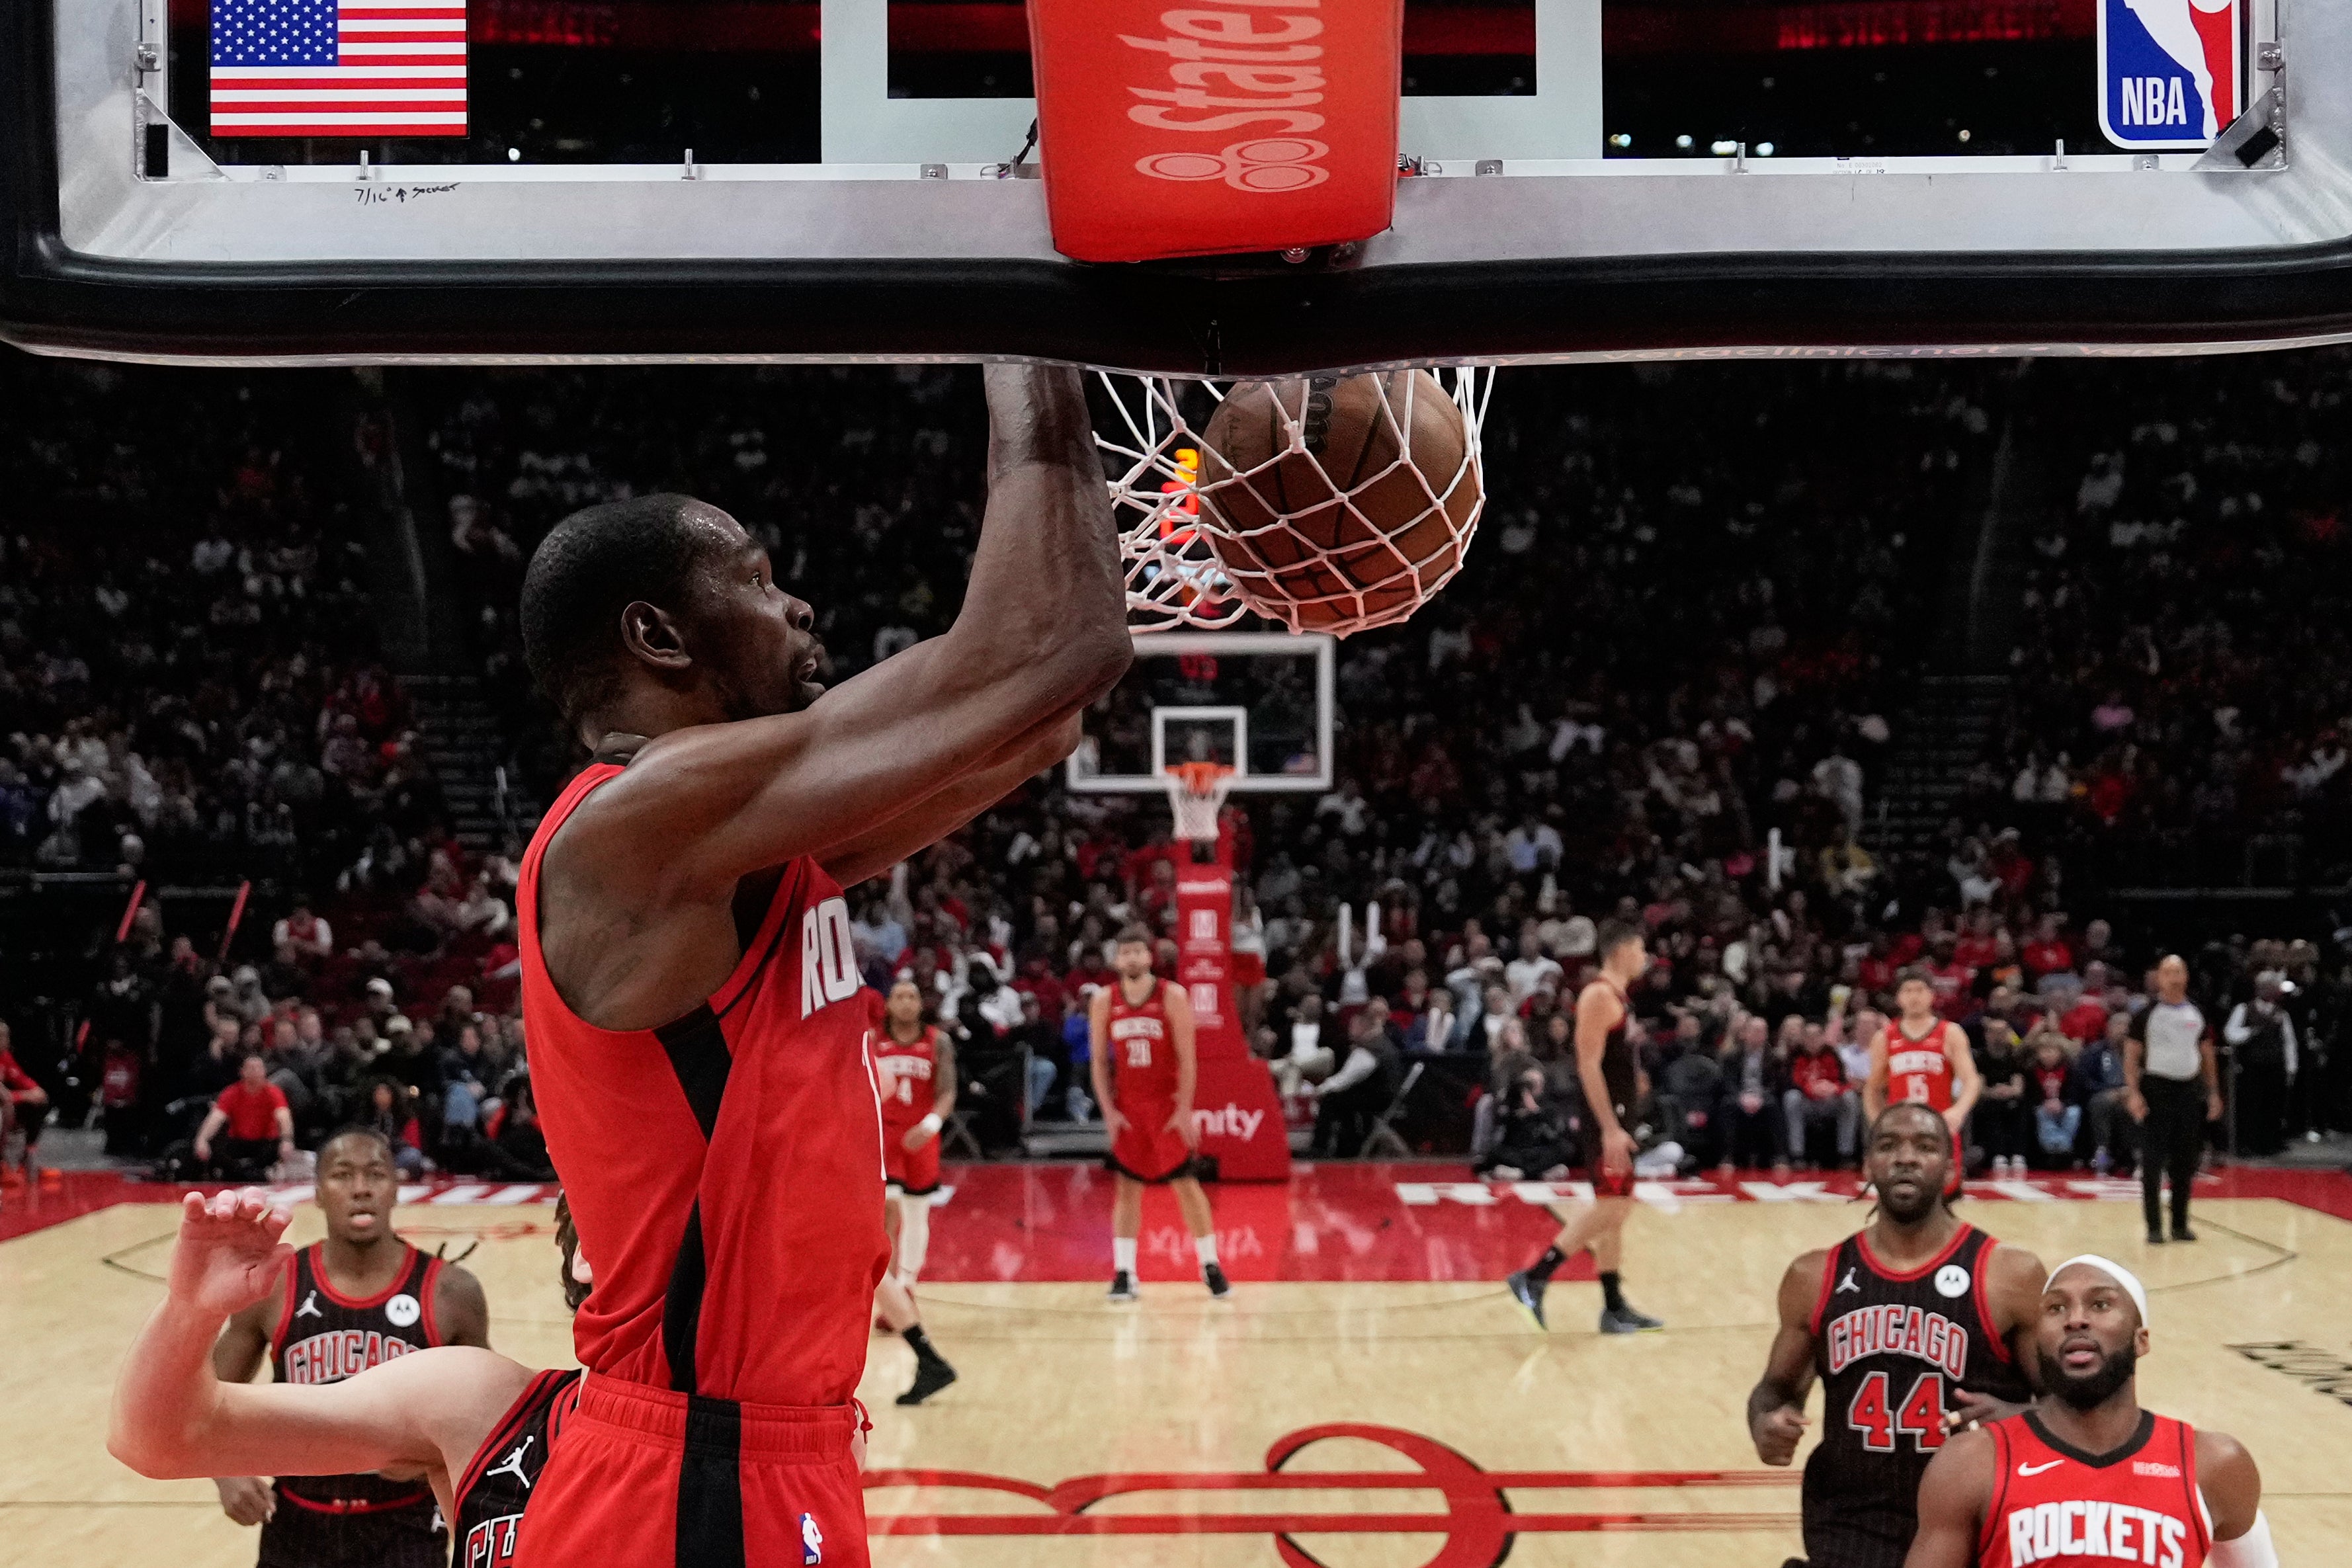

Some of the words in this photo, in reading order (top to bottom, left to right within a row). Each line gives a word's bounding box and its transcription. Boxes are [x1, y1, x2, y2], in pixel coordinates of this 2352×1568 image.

[2122, 77, 2187, 125] NBA
[896, 1076, 913, 1106] 4
[284, 1329, 422, 1384] CHICA
[1827, 1303, 1969, 1383] CHICAGO
[1847, 1370, 1951, 1454] 44
[2008, 1500, 2186, 1568] ROCKETS
